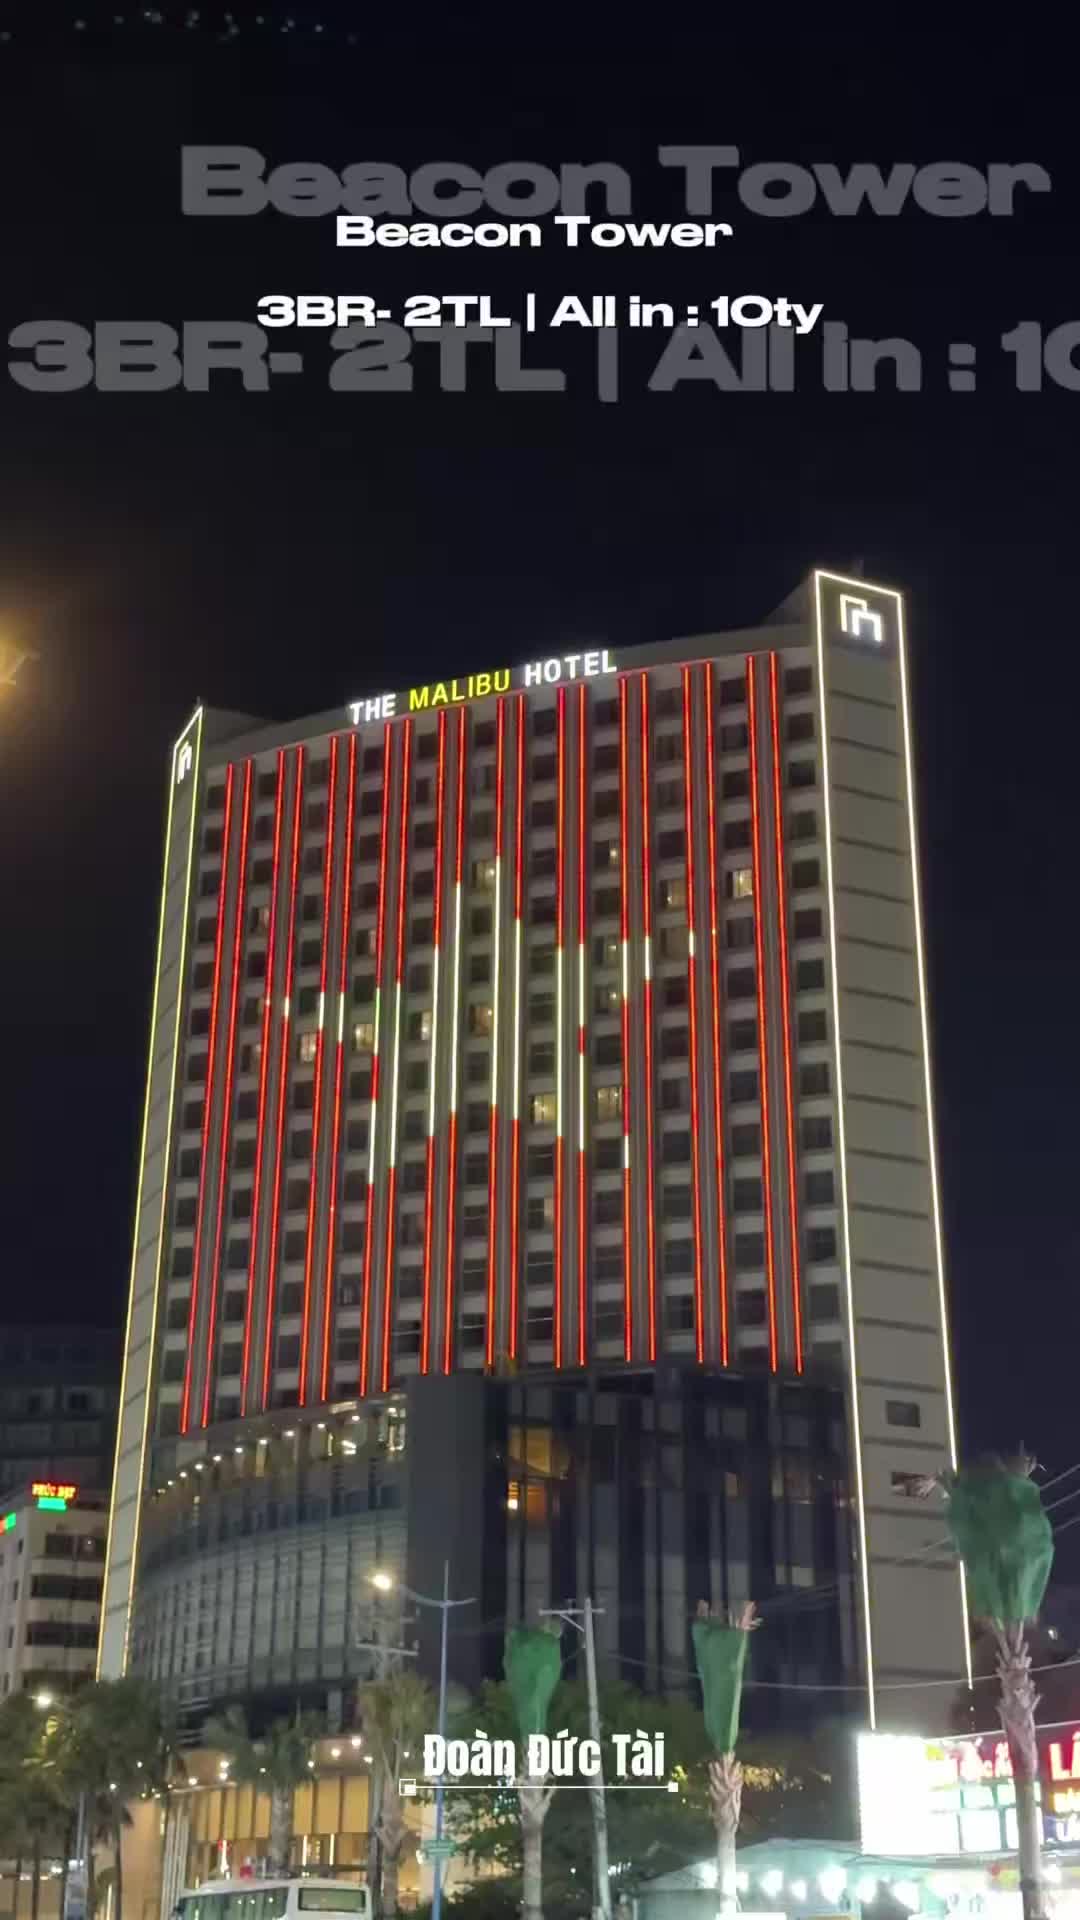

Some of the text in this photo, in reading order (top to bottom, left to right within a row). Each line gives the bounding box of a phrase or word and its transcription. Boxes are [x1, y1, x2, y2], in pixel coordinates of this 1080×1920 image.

[350, 650, 618, 725] THE MALIBU HOTEL
